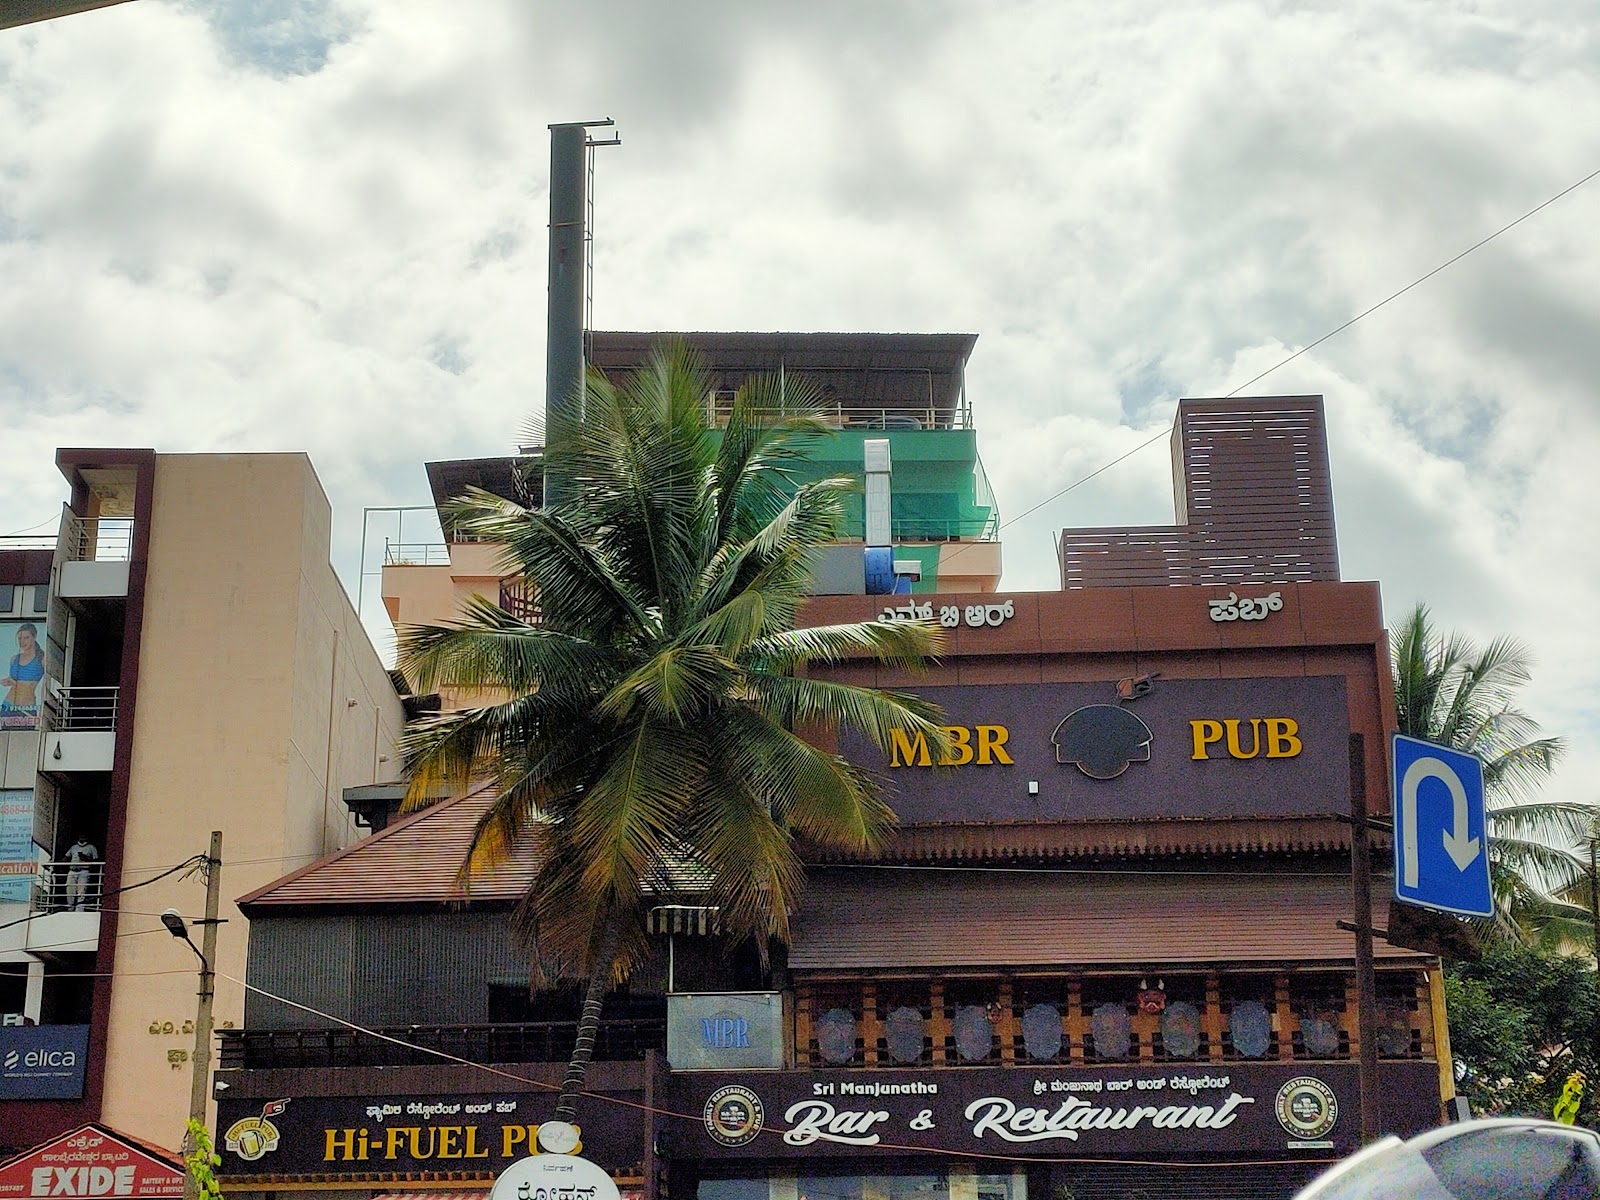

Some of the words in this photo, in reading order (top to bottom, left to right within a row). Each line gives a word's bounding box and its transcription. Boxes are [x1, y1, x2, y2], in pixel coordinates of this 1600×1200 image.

[964, 600, 1015, 628] ಆರ್
[1208, 591, 1284, 622] ಪಬ್
[889, 725, 1015, 767] MBR
[1190, 717, 1303, 761] PUB
[701, 1017, 751, 1050] MBR
[24, 1049, 76, 1067] elica
[712, 1087, 758, 1104] RESTAURANT
[813, 1083, 835, 1095] Sri
[840, 1081, 938, 1097] Manjunatha
[1106, 1079, 1133, 1091] ಬಾರ್
[1136, 1077, 1166, 1090] ಅಂಡ್
[783, 1100, 890, 1146] Bar
[909, 1109, 936, 1131] &
[964, 1092, 1255, 1143] Restaurant
[323, 1125, 489, 1162] Hi-FUEL
[31, 1165, 137, 1197] EXIDE
